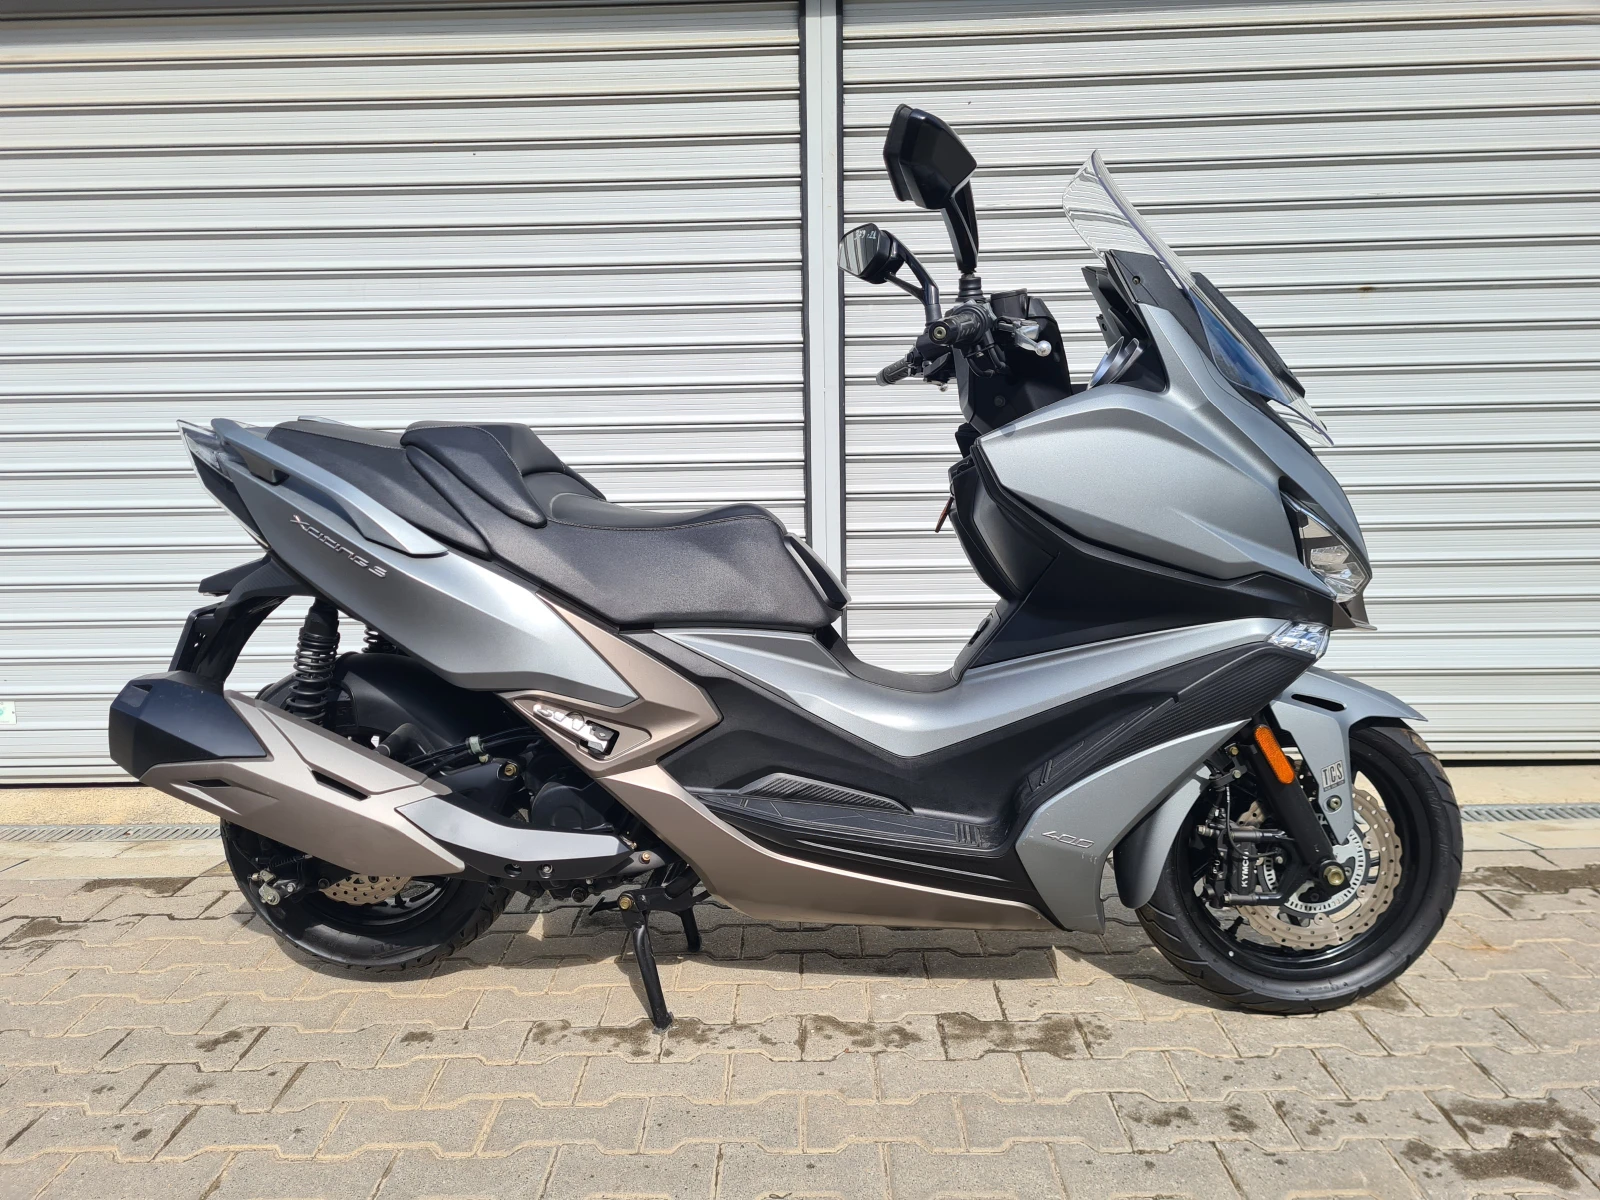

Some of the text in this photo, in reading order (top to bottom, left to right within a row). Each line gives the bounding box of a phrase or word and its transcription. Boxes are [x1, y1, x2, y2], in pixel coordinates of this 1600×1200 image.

[1322, 763, 1343, 785] TCS
[1041, 830, 1095, 848] 400
[1241, 851, 1249, 887] KYMCO
